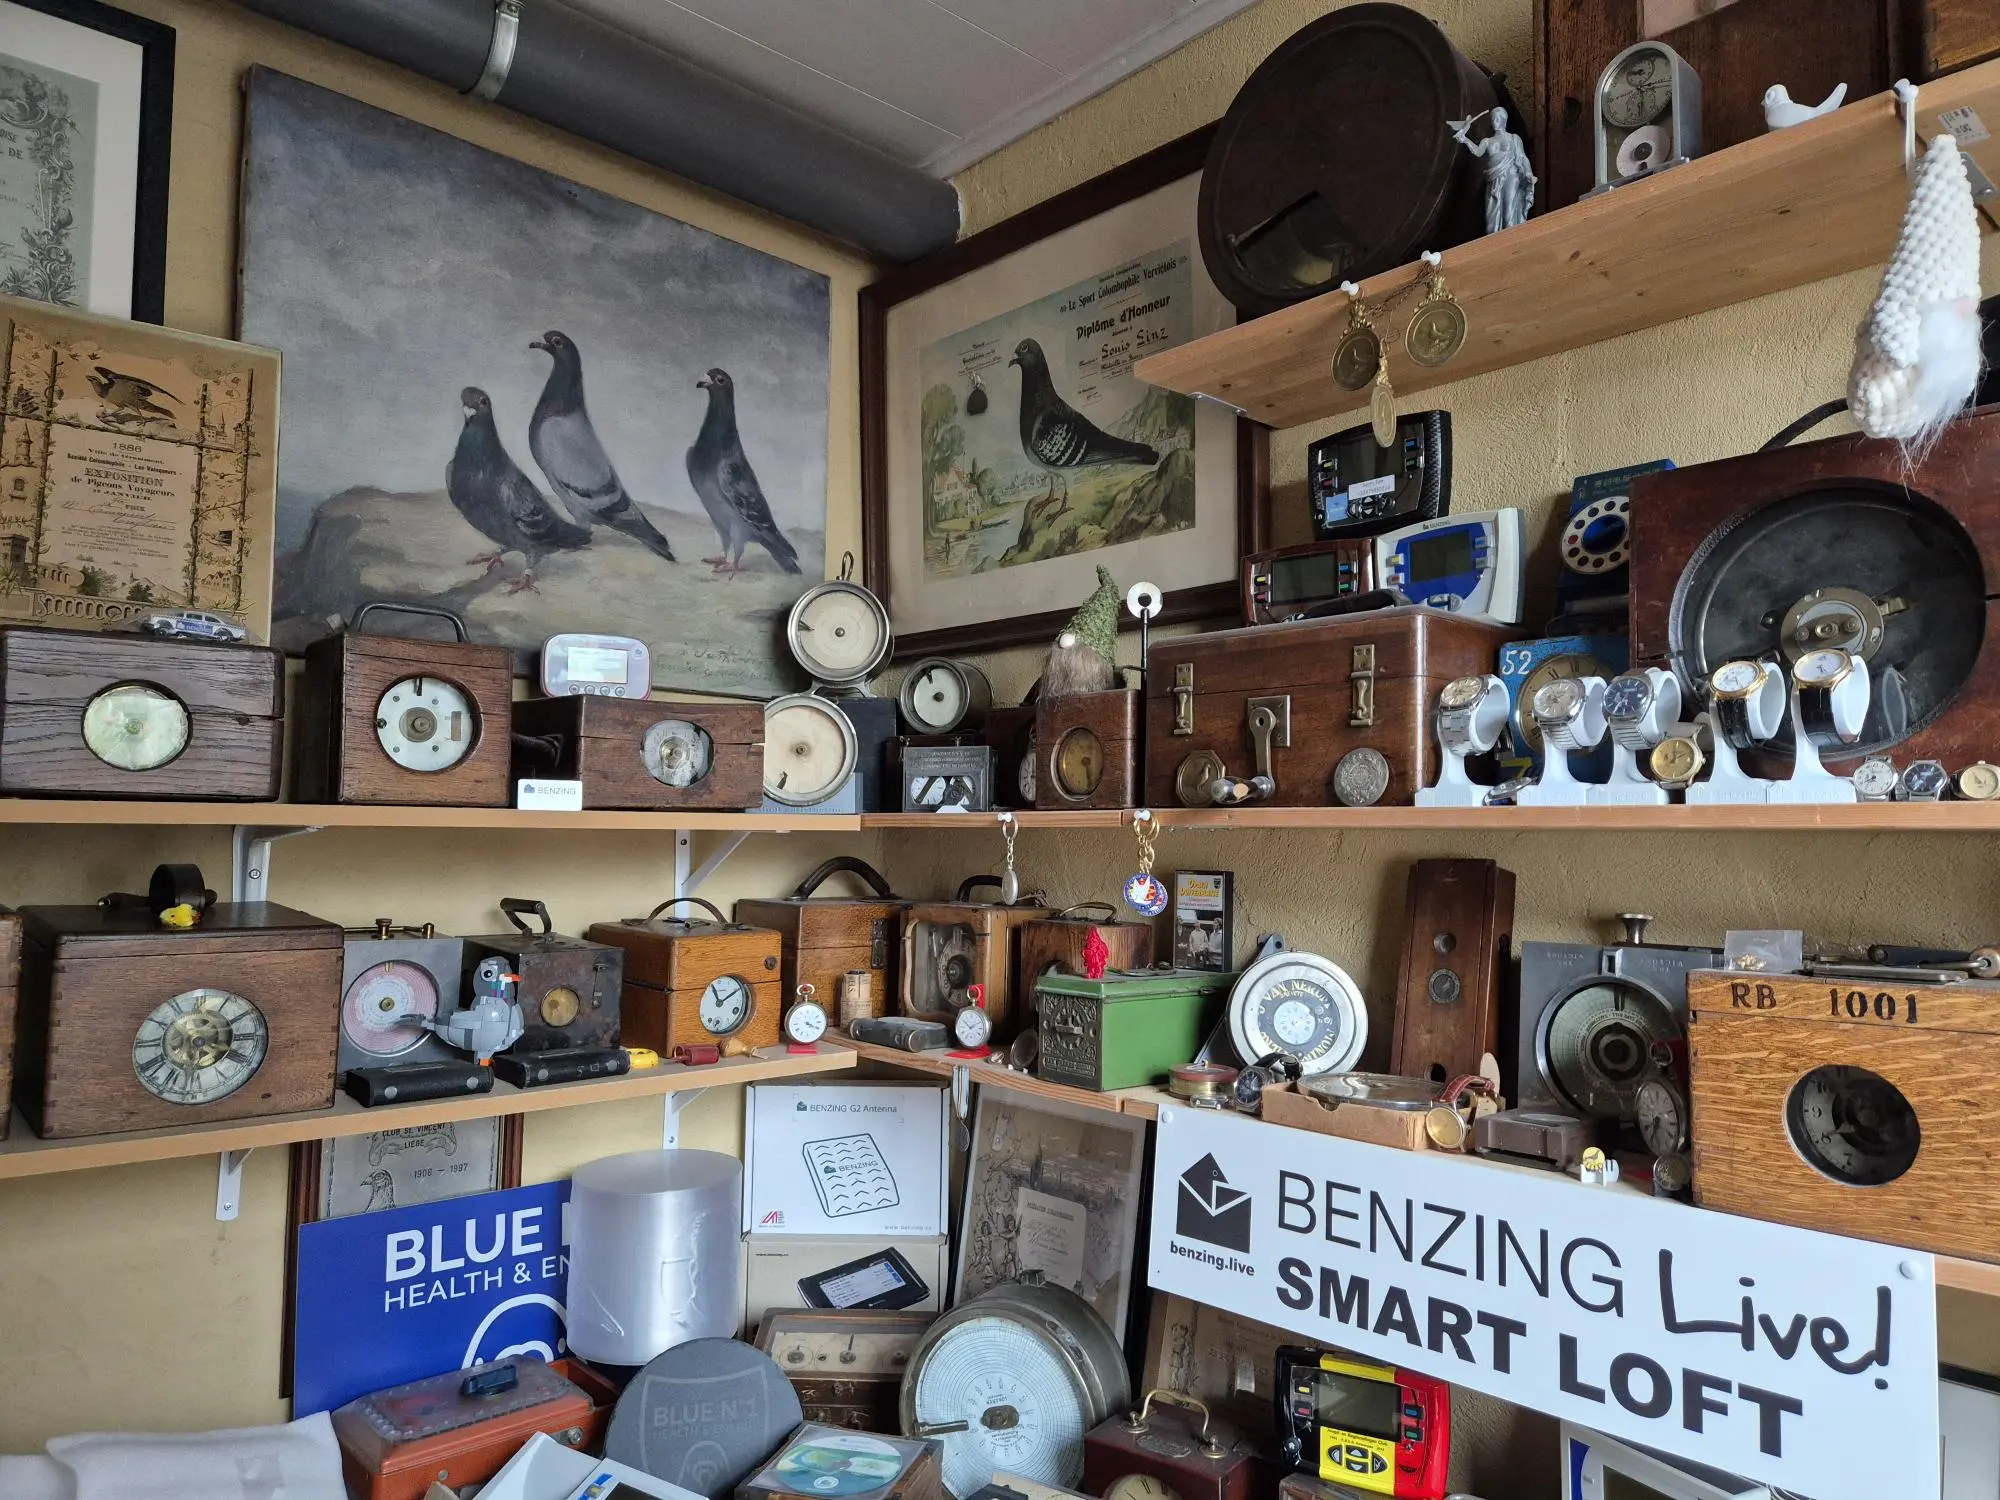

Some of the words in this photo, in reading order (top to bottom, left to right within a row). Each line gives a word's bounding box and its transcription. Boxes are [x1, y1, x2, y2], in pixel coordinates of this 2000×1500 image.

[1076, 316, 1116, 341] Diplôme
[1120, 295, 1171, 323] d'Honneur
[112, 442, 143, 454] 1886
[70, 475, 82, 484] de
[87, 478, 123, 490] Pigeons
[128, 484, 176, 497] Voyageurs
[84, 467, 164, 487] EXPOSITION
[1501, 650, 1533, 675] 52
[537, 786, 577, 796] BENZING
[1730, 982, 1777, 1010] RB
[1829, 988, 1918, 1024] 1001
[810, 1104, 847, 1113] BENZING
[850, 1104, 861, 1113] G2
[863, 1105, 898, 1113] Antenna
[838, 1159, 879, 1172] BENZING
[385, 1206, 543, 1283] BLUE
[1170, 1240, 1256, 1277] benzing.live
[385, 1266, 503, 1313] HEALTH
[513, 1262, 532, 1284] &
[1278, 1169, 1625, 1319] BENZING
[1658, 1248, 1892, 1390] Live!
[1275, 1256, 1527, 1375] SMART
[1559, 1332, 1803, 1459] LOFT
[653, 1401, 714, 1427] BLUE
